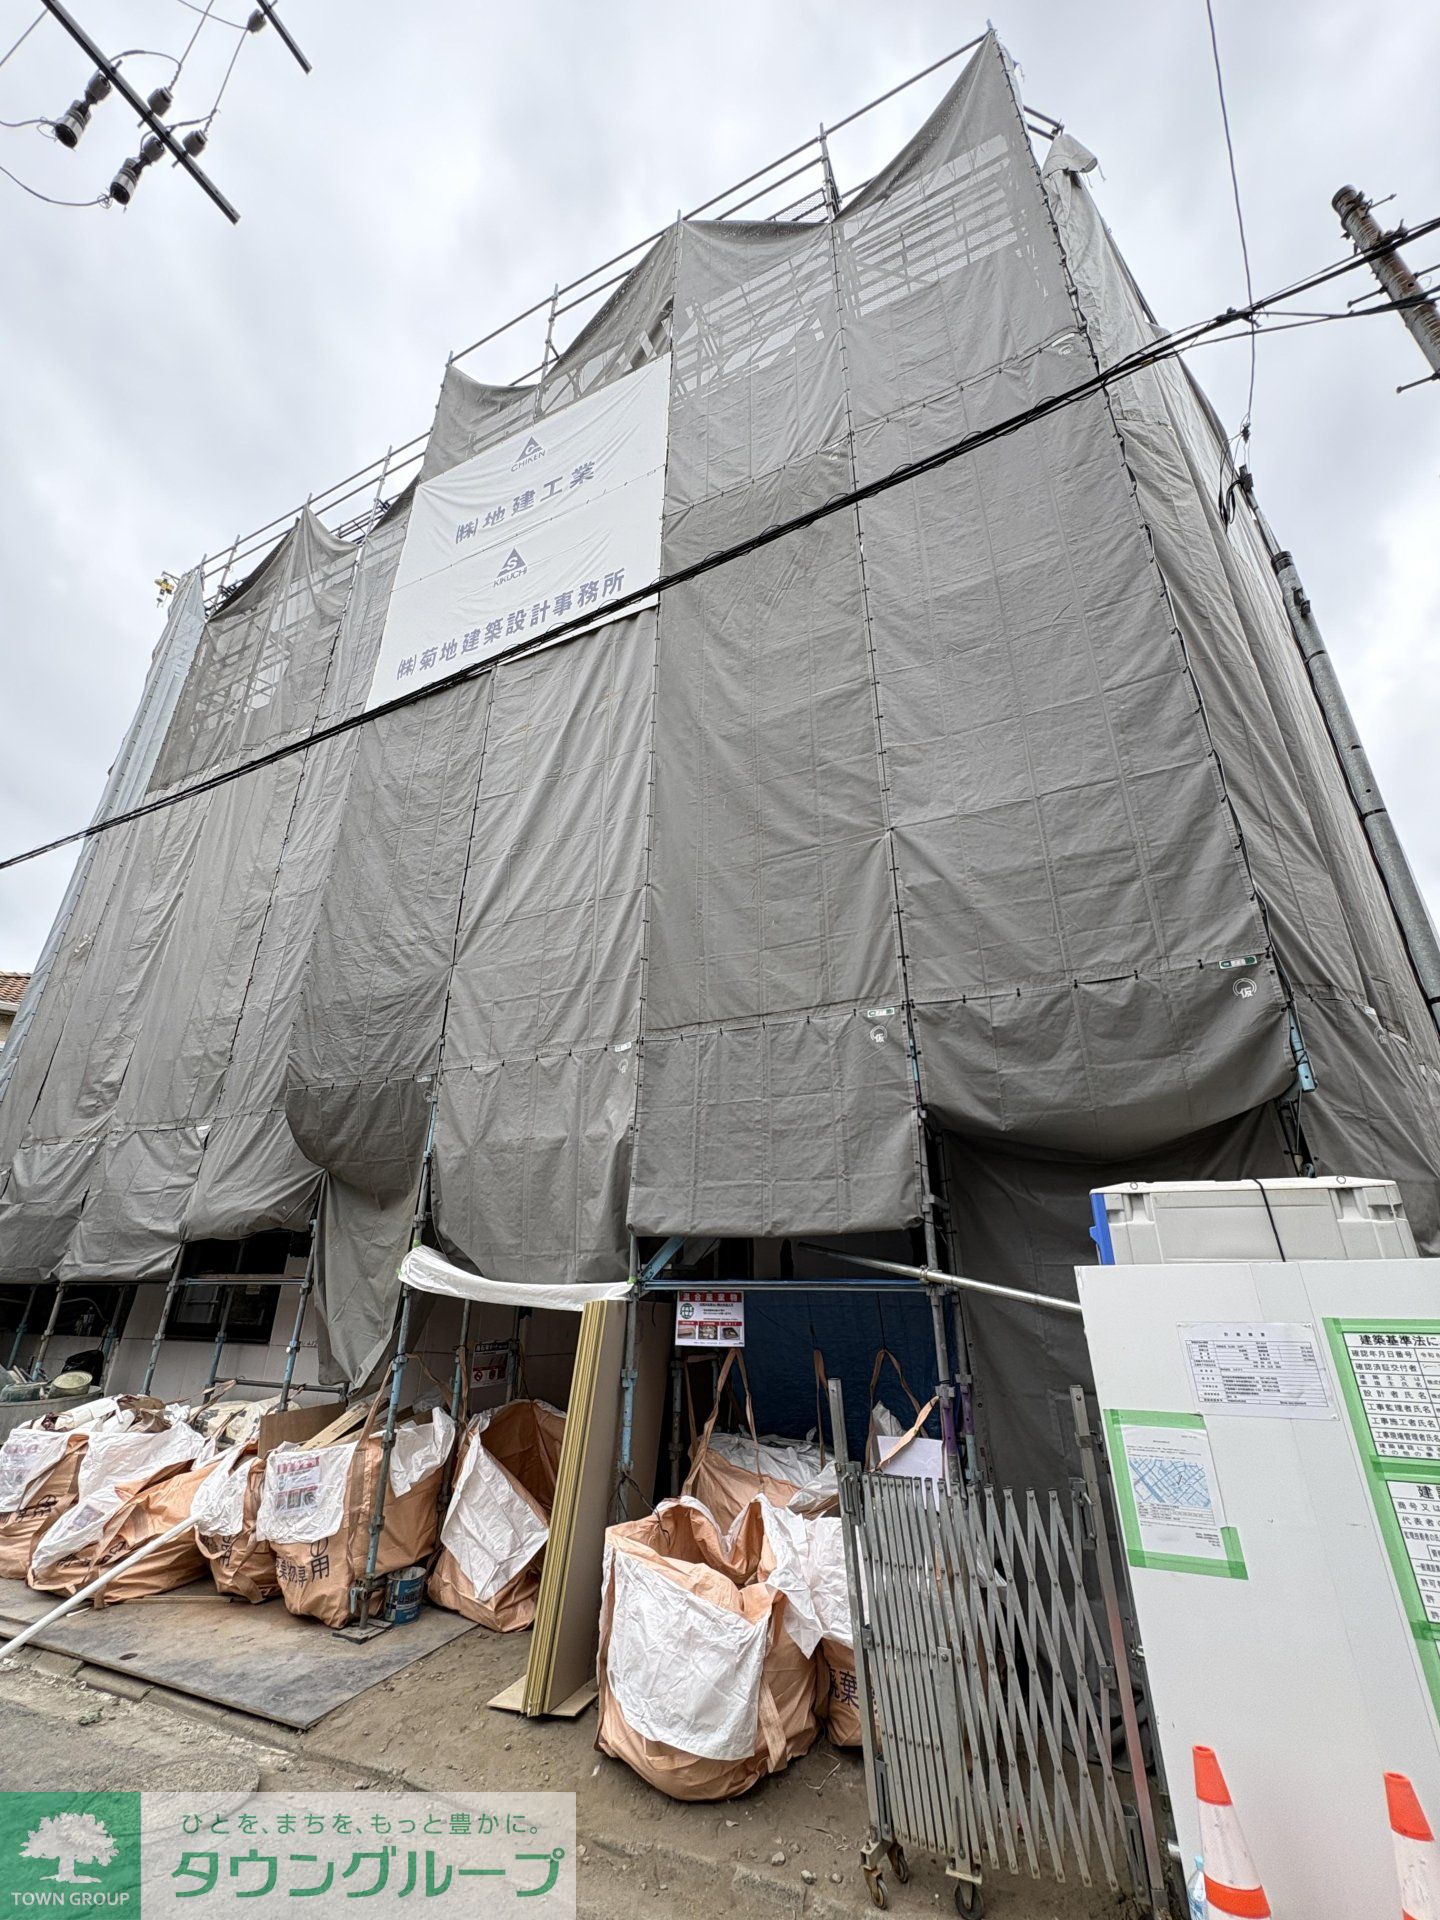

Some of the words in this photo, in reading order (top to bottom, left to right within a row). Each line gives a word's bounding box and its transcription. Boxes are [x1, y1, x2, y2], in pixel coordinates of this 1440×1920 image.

[510, 450, 546, 473] CHIKEN
[493, 566, 528, 588] KIKUCHI
[1350, 1349, 1413, 1359] 確認年月日番号
[1355, 1363, 1418, 1372] 確認済証交付者
[1363, 1389, 1427, 1400] 設計者氏名
[1367, 1403, 1431, 1414] 工事監理者氏名
[1372, 1417, 1436, 1428] 工事施工者氏名
